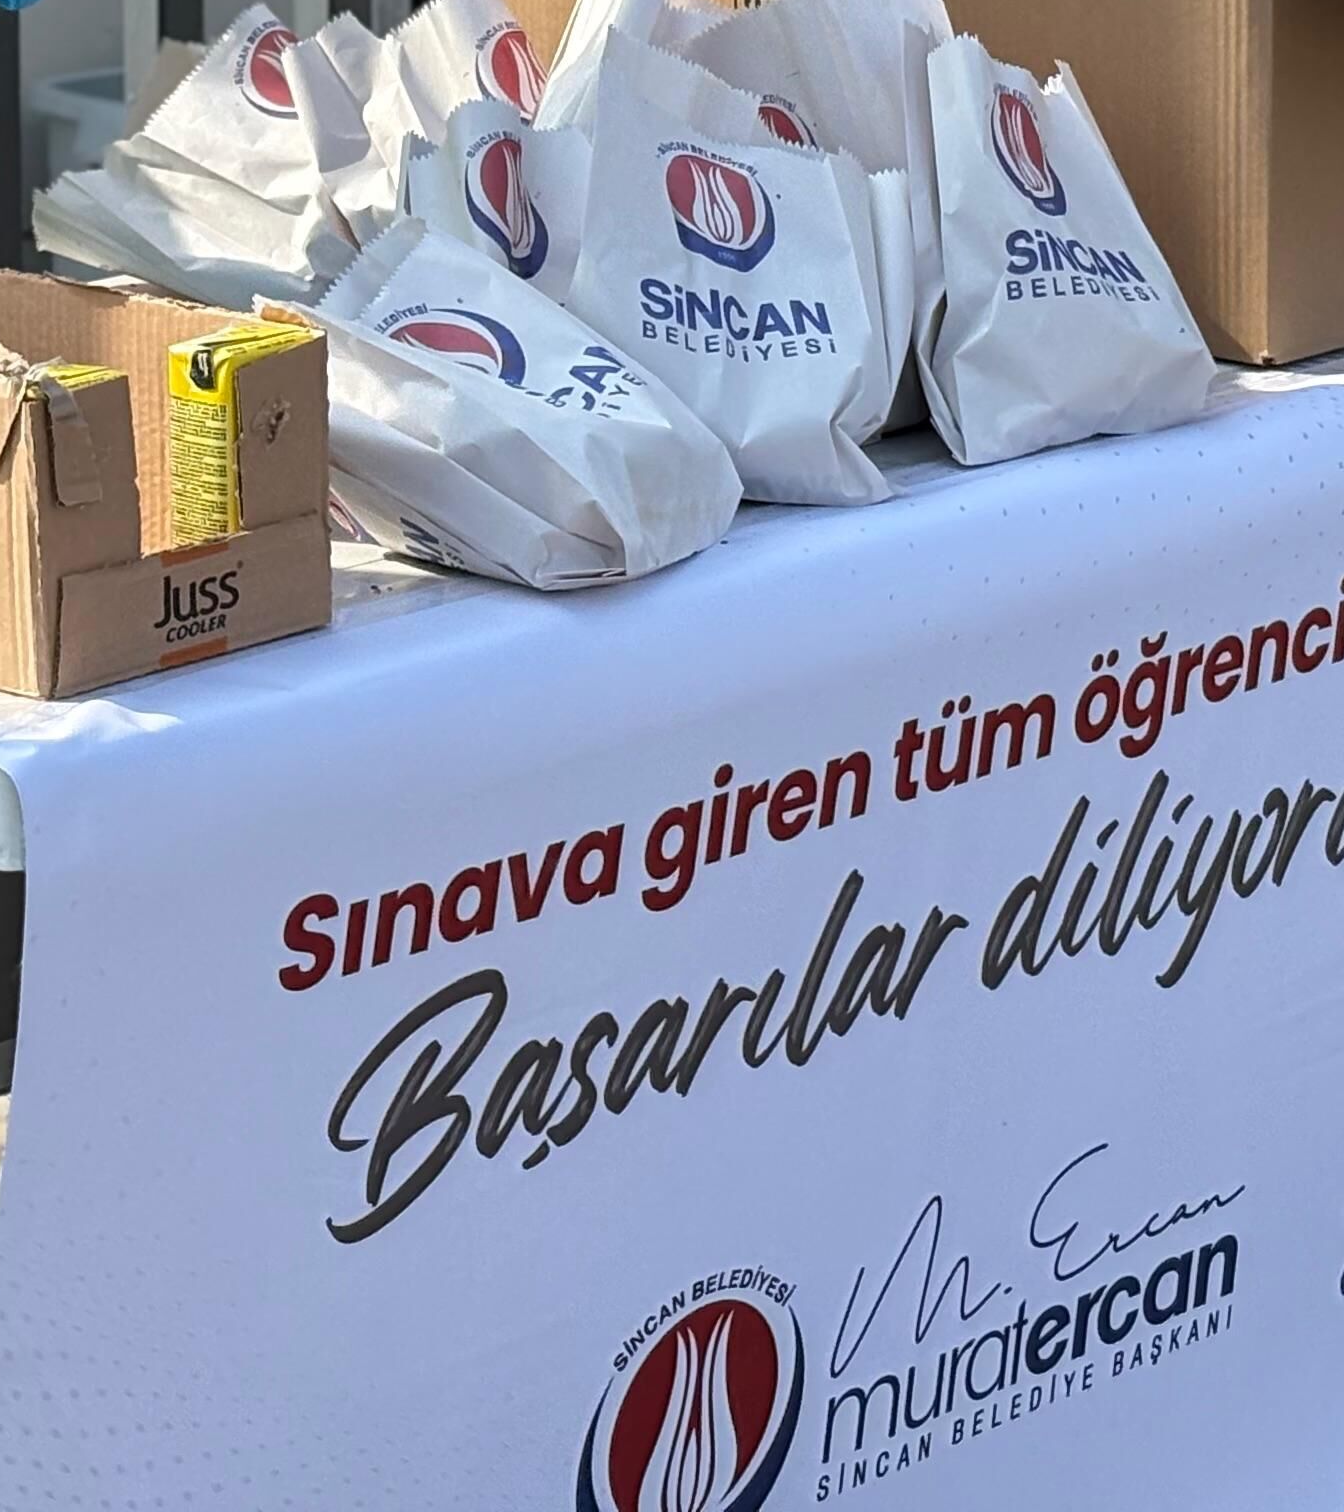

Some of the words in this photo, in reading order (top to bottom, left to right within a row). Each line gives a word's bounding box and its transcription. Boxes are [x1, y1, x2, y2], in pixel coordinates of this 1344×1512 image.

[153, 570, 240, 629] Juss
[166, 614, 227, 643] COOLER
[278, 825, 626, 992] Sınava
[640, 740, 872, 913] giren
[892, 691, 1056, 800] tüm
[327, 872, 967, 1245] Başarılar
[612, 1290, 687, 1373] SİNCAN
[691, 1265, 798, 1308] BELEDİYESİ
[1111, 1303, 1236, 1386] BAŞKANI
